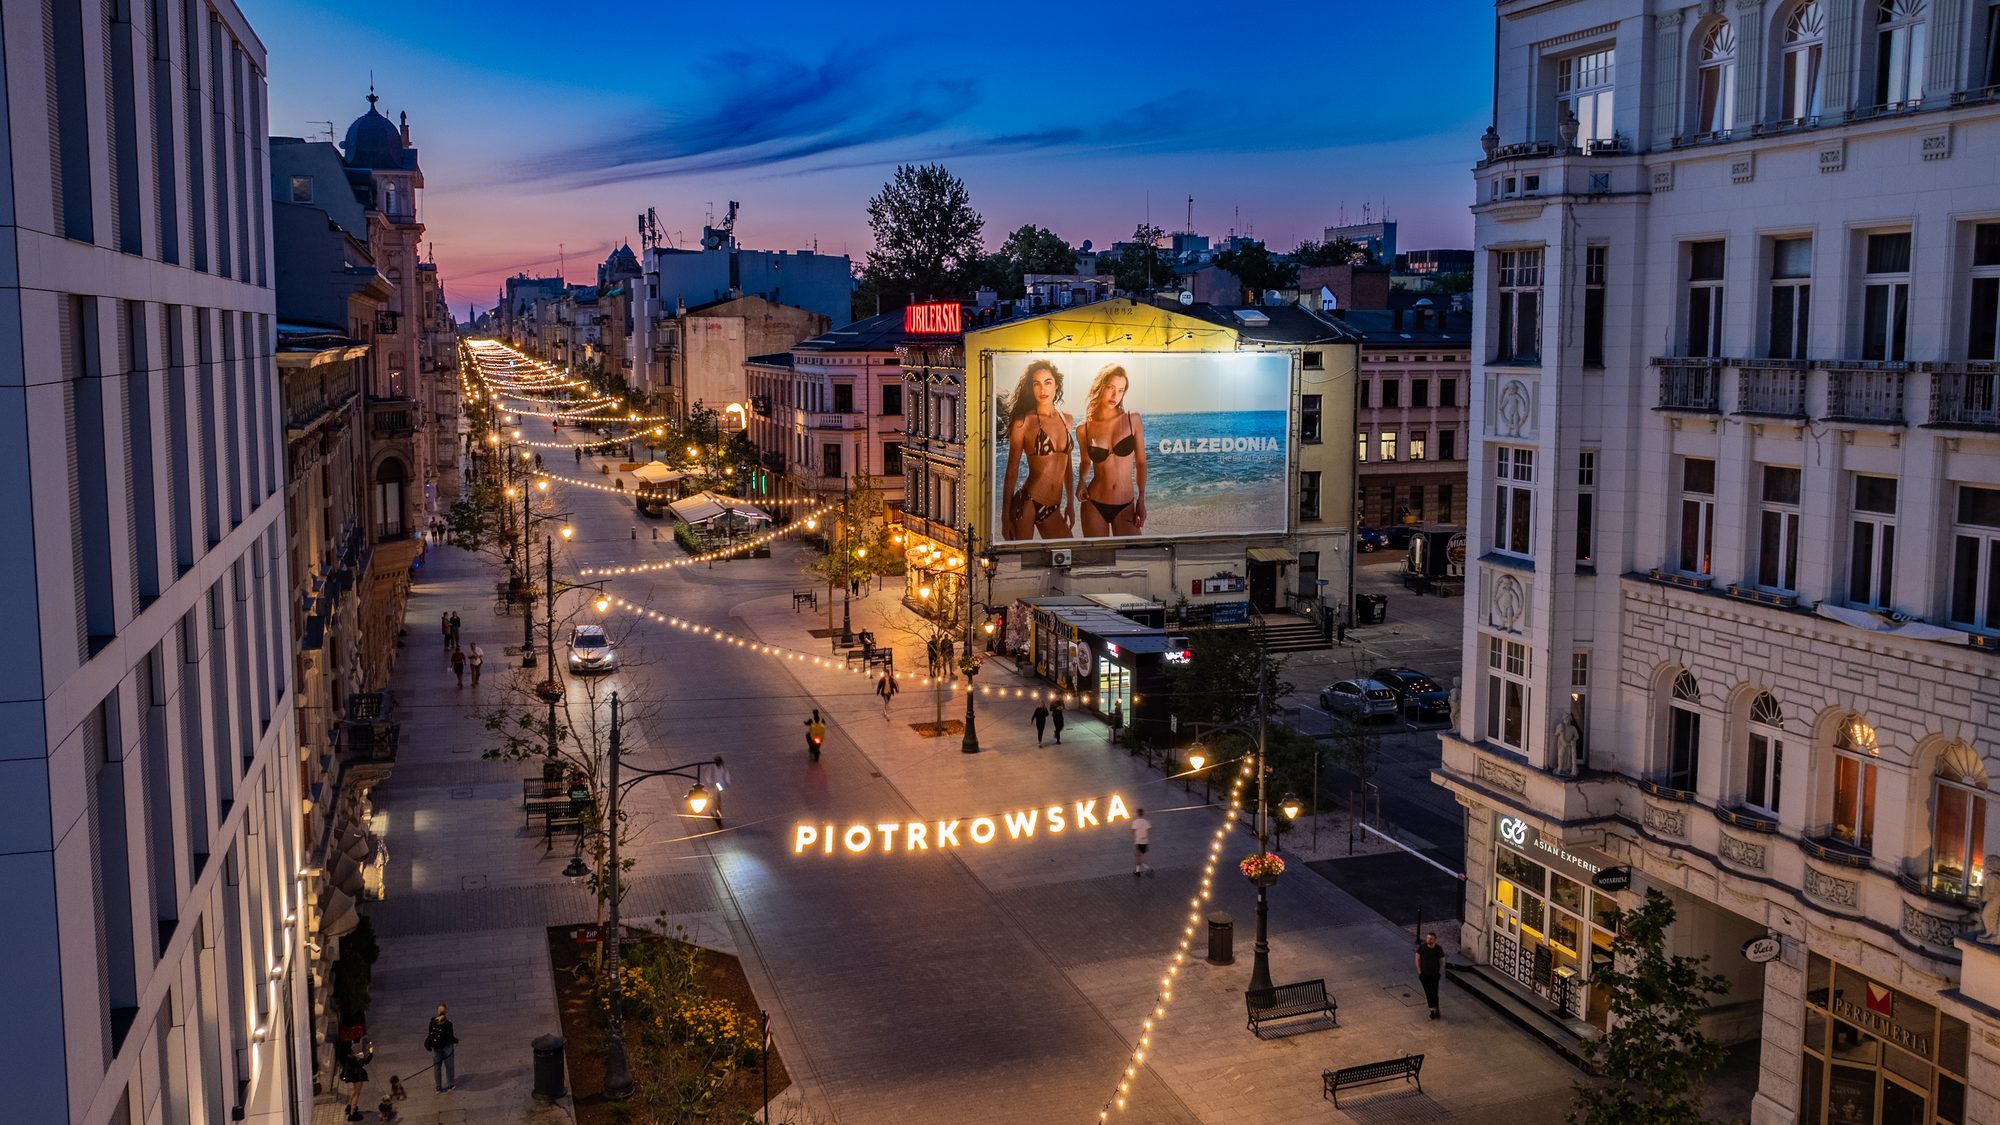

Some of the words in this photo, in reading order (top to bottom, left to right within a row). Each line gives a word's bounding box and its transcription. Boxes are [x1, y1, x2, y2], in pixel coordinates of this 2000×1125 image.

[906, 303, 960, 332] JUBILERSKI
[1159, 437, 1280, 454] CALZEDONIA
[794, 794, 1131, 853] PIOTRKOWSKA
[1533, 838, 1559, 857] ASIAN
[1598, 876, 1628, 885] NOTARIUSZ
[1835, 997, 1930, 1055] PERFUMERIA
